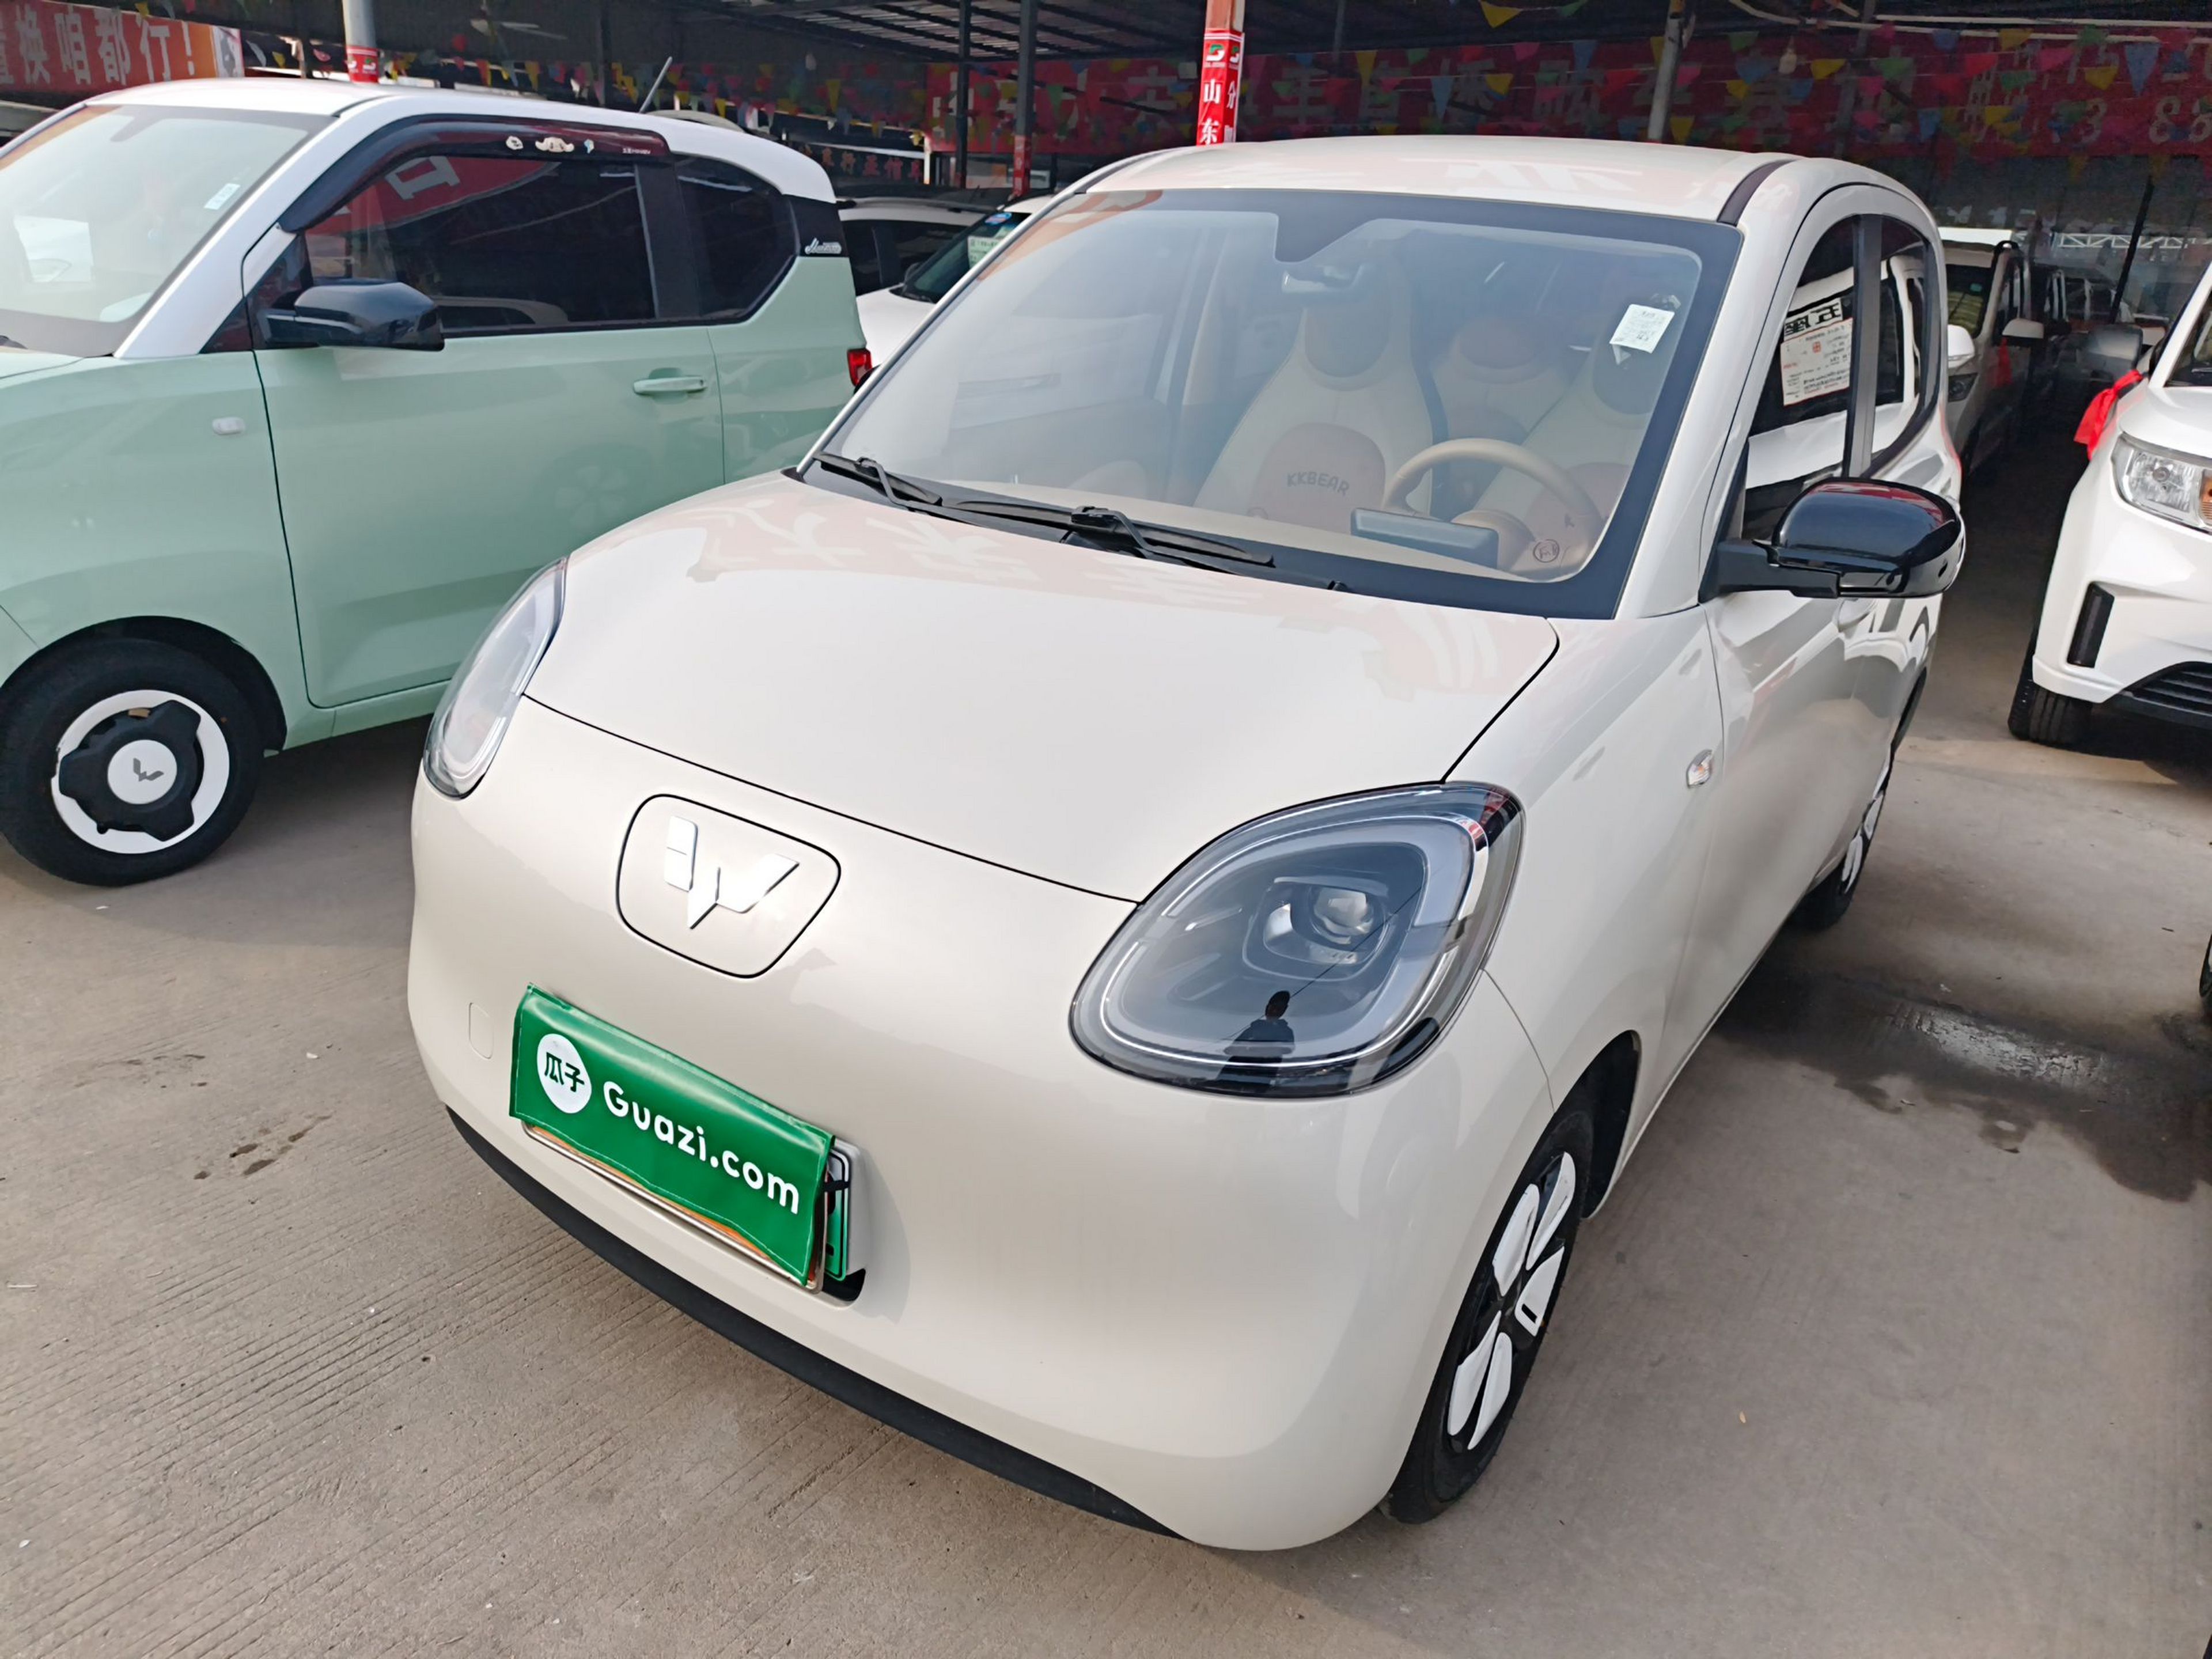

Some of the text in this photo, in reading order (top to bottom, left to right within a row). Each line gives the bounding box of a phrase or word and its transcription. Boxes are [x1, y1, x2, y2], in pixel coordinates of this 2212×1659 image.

[1199, 79, 1221, 145] 山东
[1286, 471, 1350, 497] KKBEAR
[544, 1052, 585, 1093] 瓜子
[603, 1081, 799, 1214] Guazi.com
